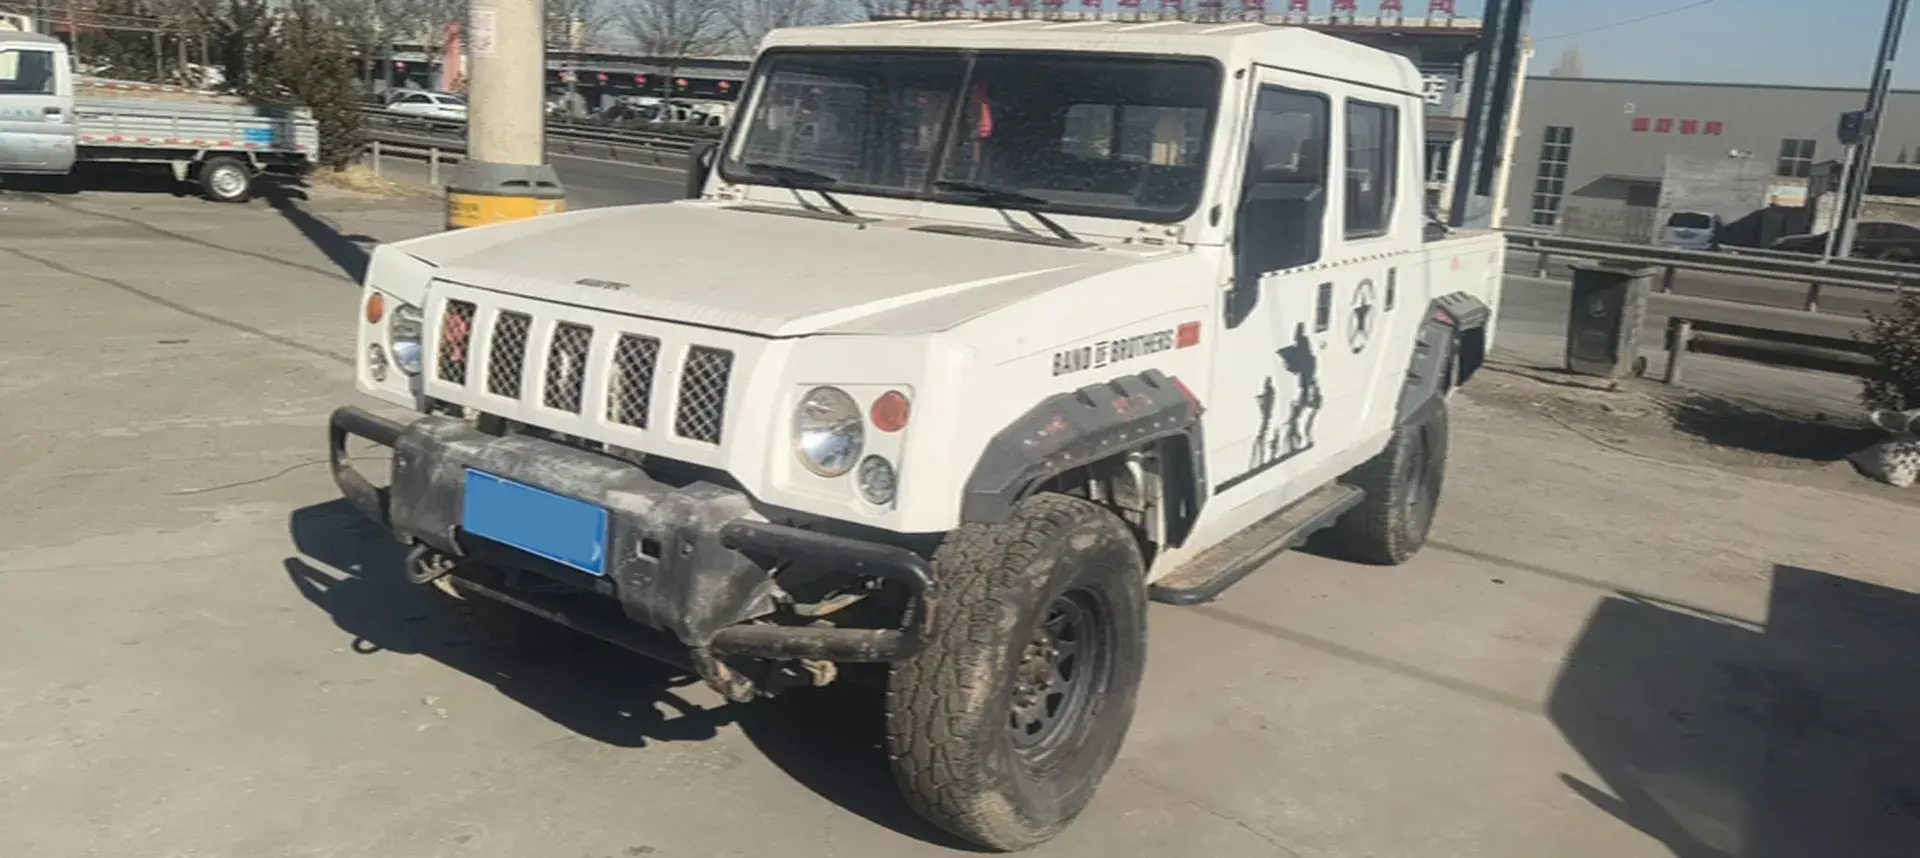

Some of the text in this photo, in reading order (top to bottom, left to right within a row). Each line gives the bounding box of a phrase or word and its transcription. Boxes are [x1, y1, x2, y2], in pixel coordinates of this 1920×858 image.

[1053, 346, 1091, 376] BAND
[1094, 341, 1109, 368] OF
[1110, 329, 1174, 362] BROTHERS
